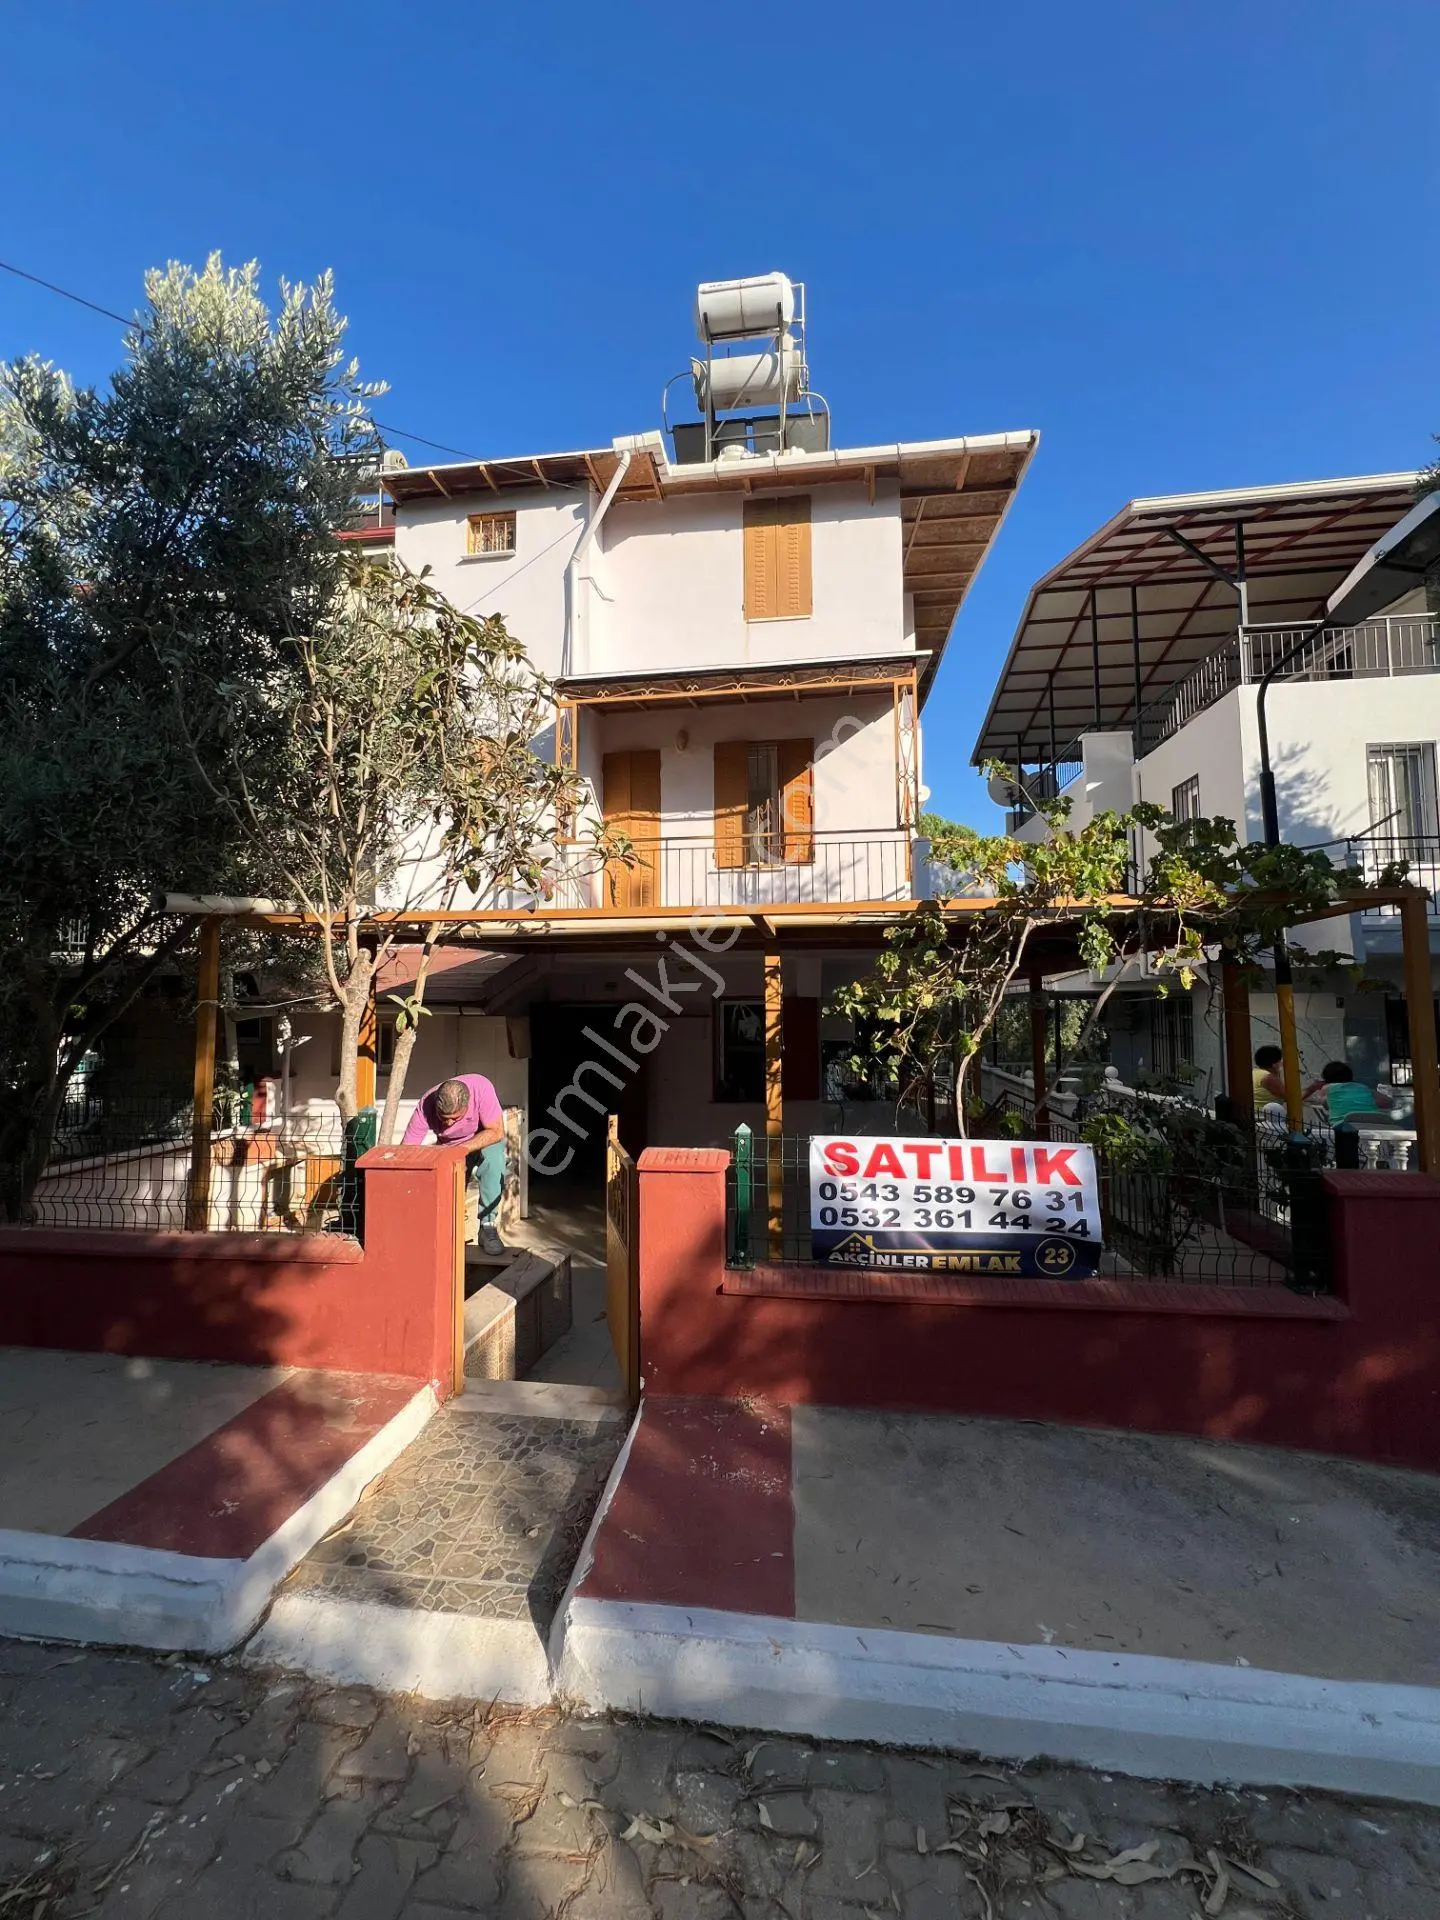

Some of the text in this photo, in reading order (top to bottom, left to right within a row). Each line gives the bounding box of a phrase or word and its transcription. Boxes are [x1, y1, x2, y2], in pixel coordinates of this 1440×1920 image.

[823, 1141, 1083, 1186] SATILIK
[818, 1182, 1085, 1212] 0543 589 76 31
[819, 1206, 1091, 1238] 0532 361 44 24
[931, 1256, 1021, 1272] EMLAK
[1044, 1248, 1070, 1264] 23
